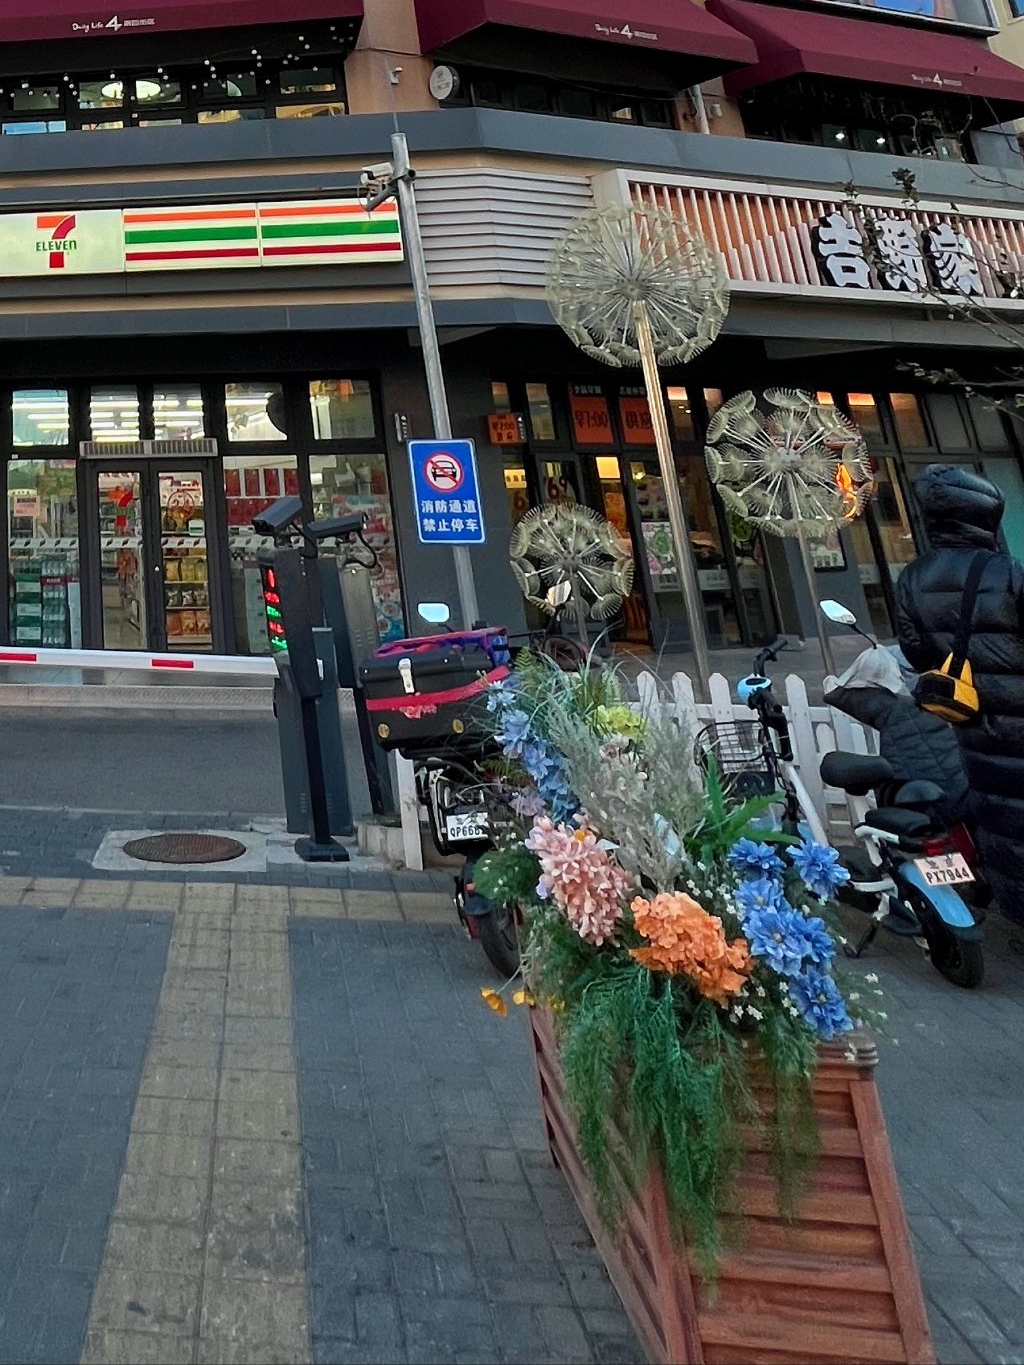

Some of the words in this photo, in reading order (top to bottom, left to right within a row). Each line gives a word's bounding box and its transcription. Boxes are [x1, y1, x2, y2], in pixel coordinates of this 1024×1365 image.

[421, 499, 477, 513] 消防通道
[422, 518, 479, 532] 禁止停车
[926, 867, 970, 884] PX7944
